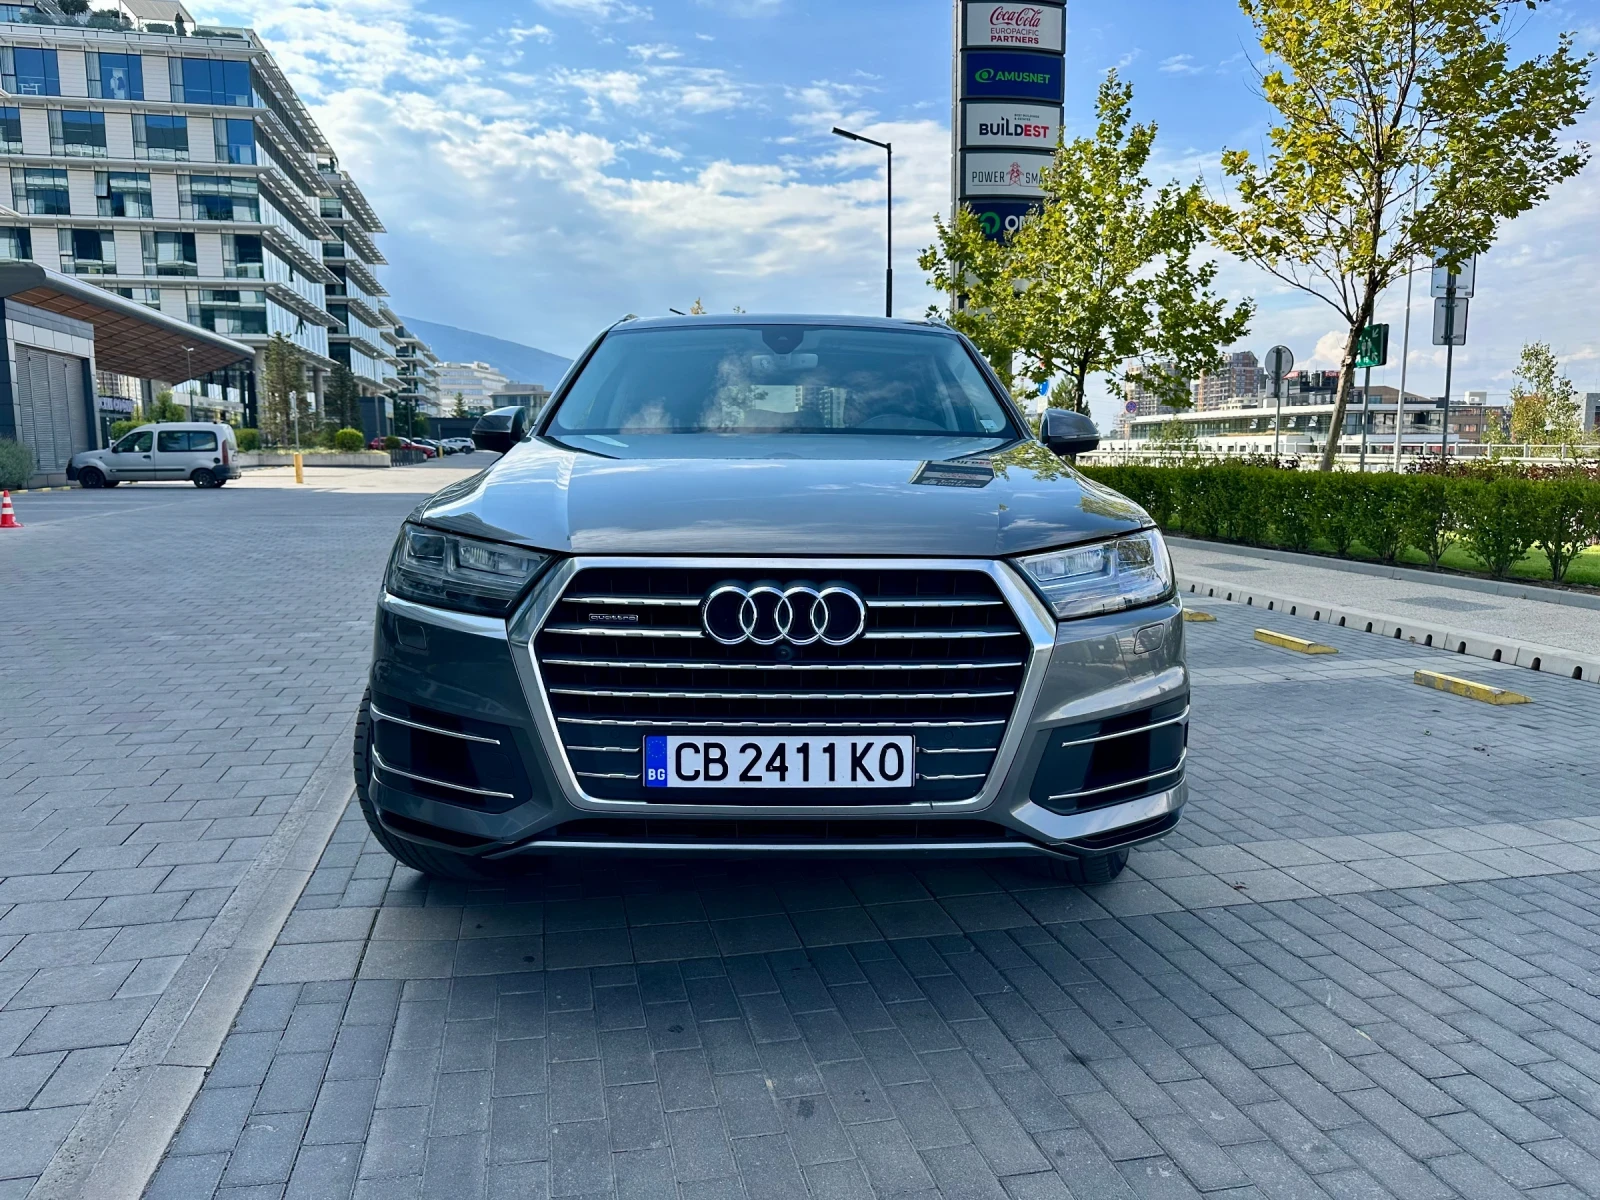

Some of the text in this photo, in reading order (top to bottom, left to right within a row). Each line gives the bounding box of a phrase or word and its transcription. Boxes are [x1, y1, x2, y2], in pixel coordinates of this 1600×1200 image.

[990, 6, 1043, 28] Coca-Cola
[990, 27, 1039, 36] EUROPACIFIC
[990, 35, 1039, 44] PARTNERS
[996, 71, 1050, 84] AMUSNET
[972, 171, 1044, 184] POWER SMA
[648, 768, 666, 781] BG
